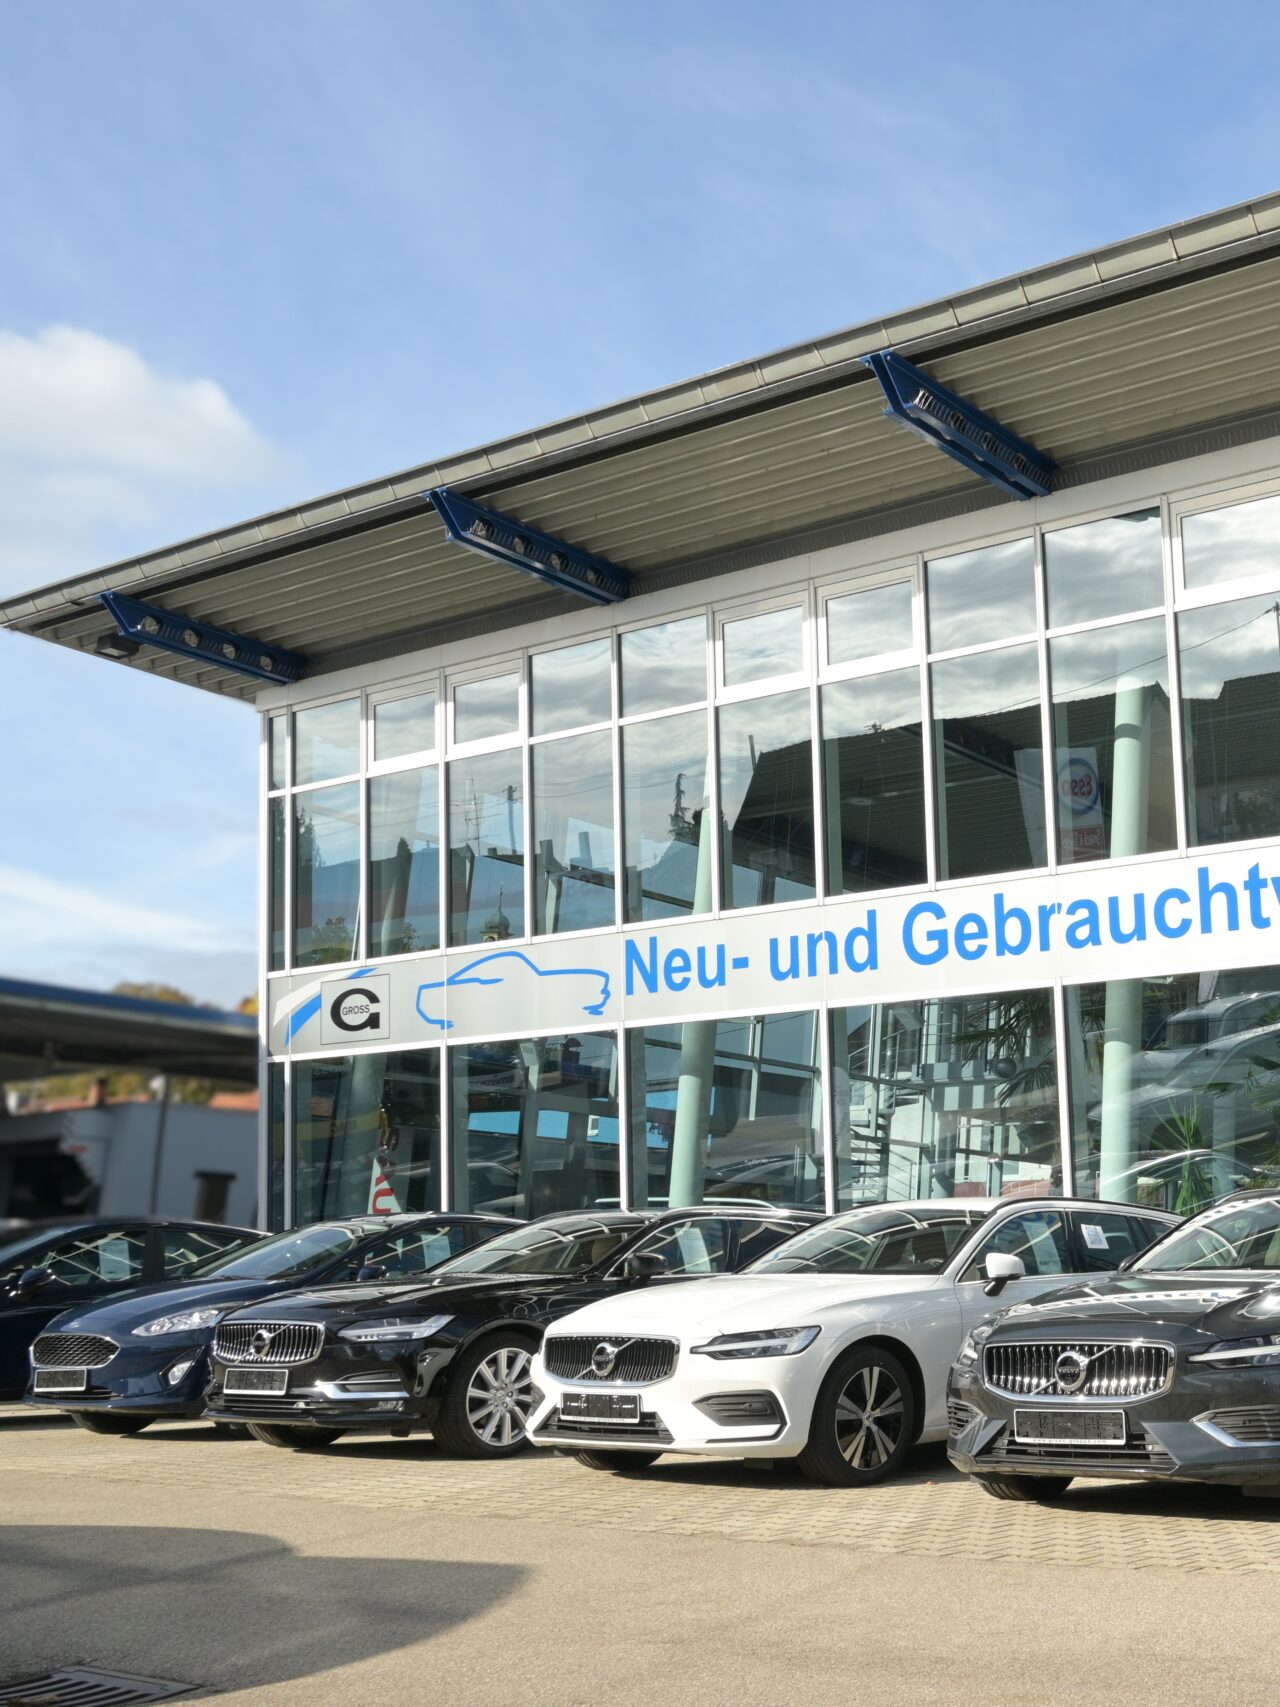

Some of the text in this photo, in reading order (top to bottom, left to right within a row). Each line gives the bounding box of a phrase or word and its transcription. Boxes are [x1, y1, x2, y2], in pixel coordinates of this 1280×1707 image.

[625, 935, 750, 997] Neu-
[769, 908, 879, 982] und
[342, 1004, 370, 1016] GROSS
